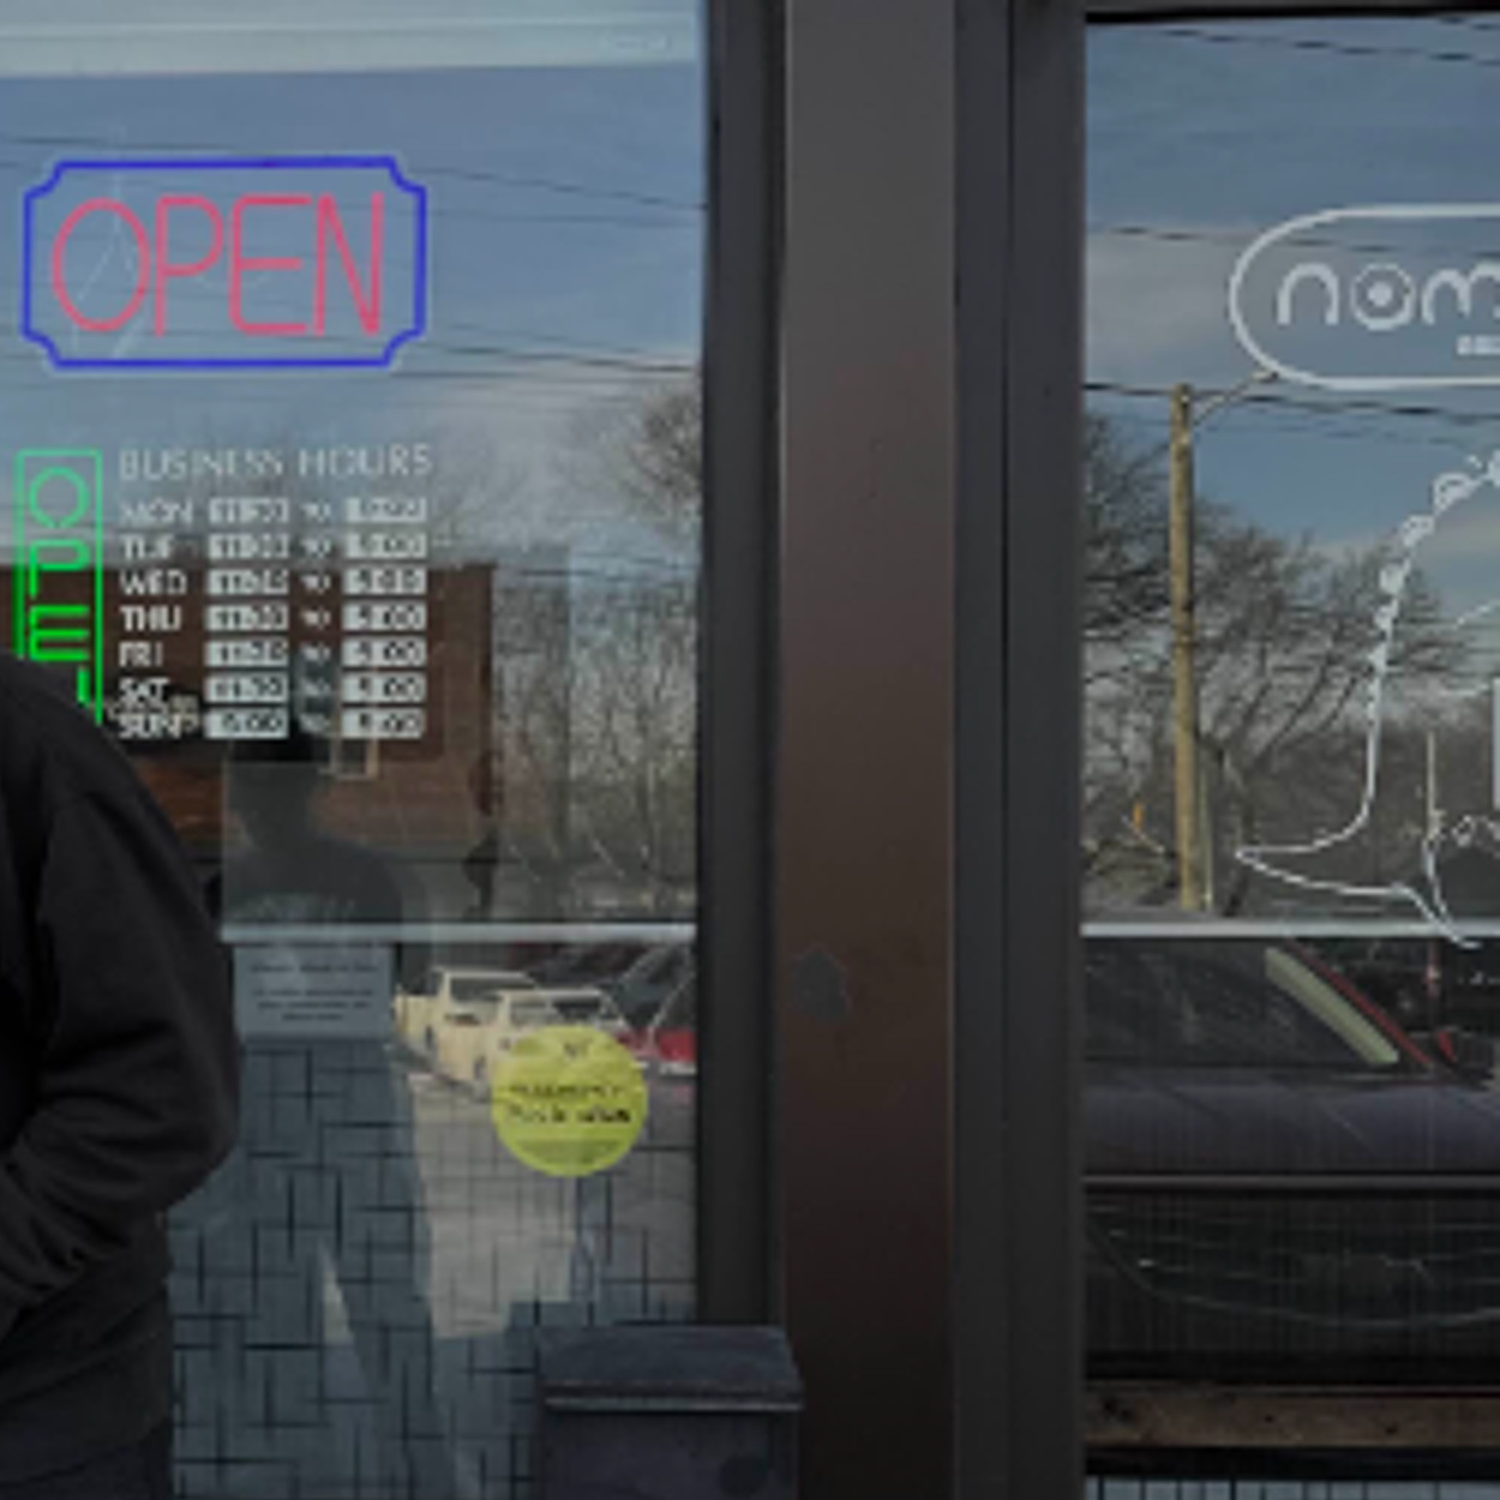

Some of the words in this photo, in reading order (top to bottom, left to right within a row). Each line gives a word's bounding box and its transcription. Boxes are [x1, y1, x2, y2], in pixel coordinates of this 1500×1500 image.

[50, 191, 385, 337] OPEN
[119, 449, 284, 480] BUSINESS
[301, 444, 434, 477] HOURS
[120, 570, 187, 596] WED
[120, 605, 182, 631] THU
[119, 641, 163, 668] FRI
[119, 677, 169, 703] SAT
[120, 713, 181, 739] SUN
